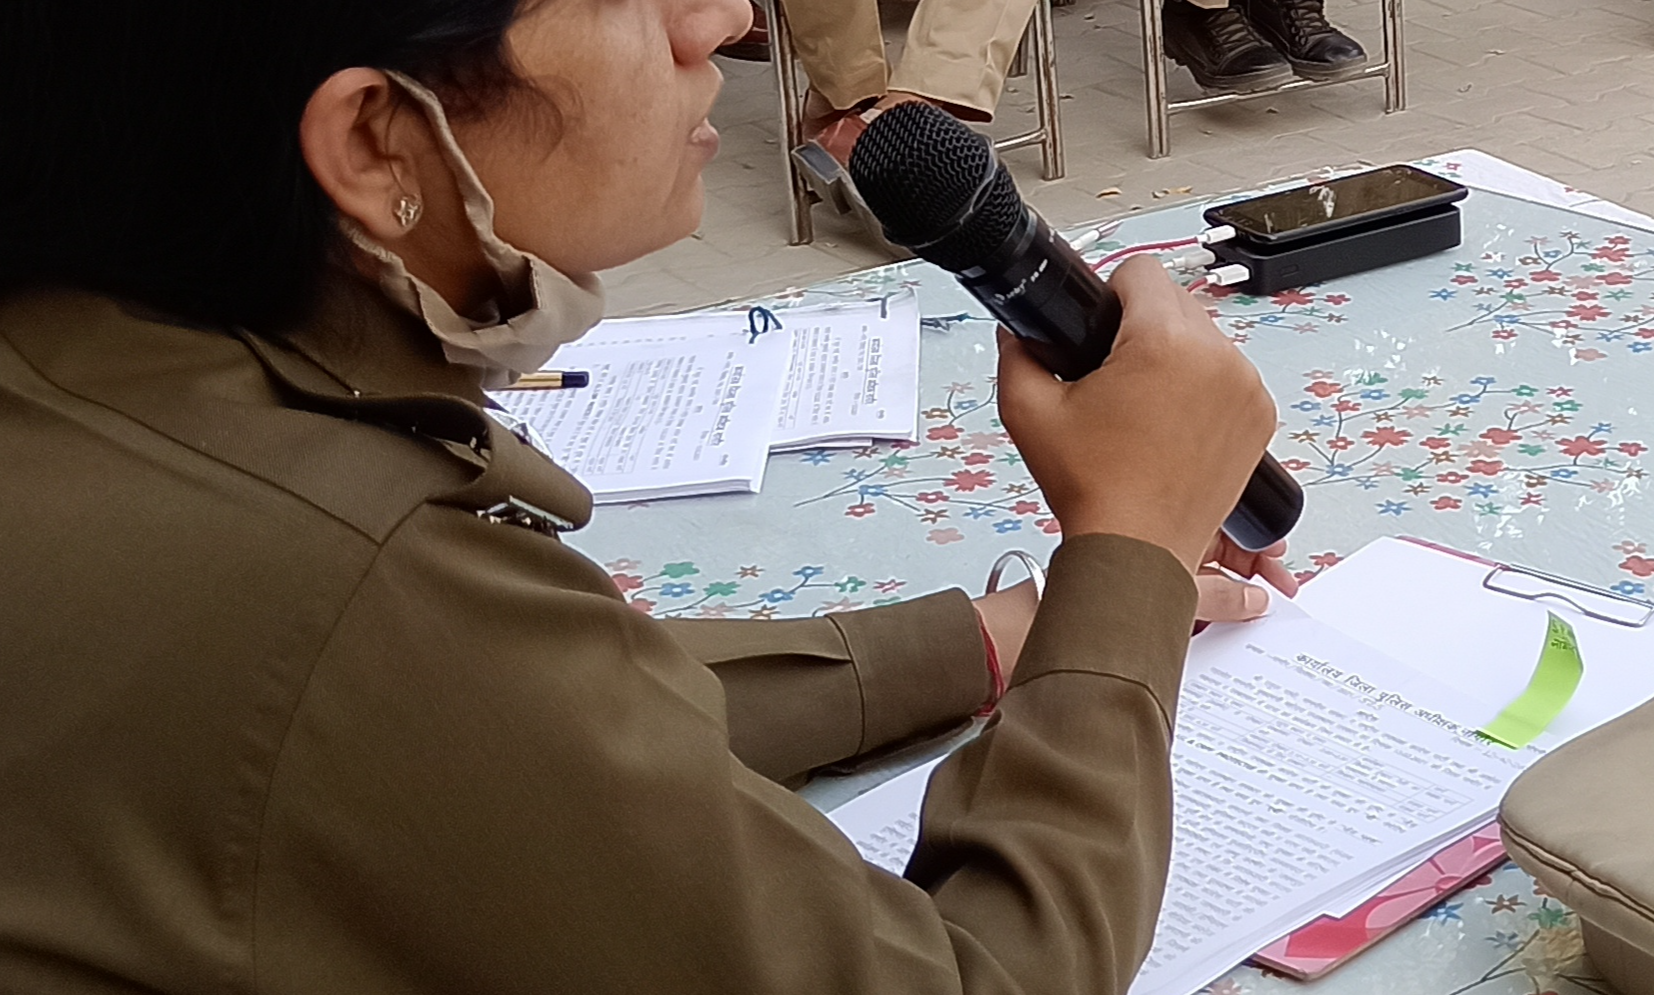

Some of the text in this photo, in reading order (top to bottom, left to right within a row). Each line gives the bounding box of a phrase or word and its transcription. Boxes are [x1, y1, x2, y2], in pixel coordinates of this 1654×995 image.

[1296, 654, 1344, 679] कार्यालय
[1344, 675, 1377, 694] जिला
[1375, 691, 1412, 711] पुलिस
